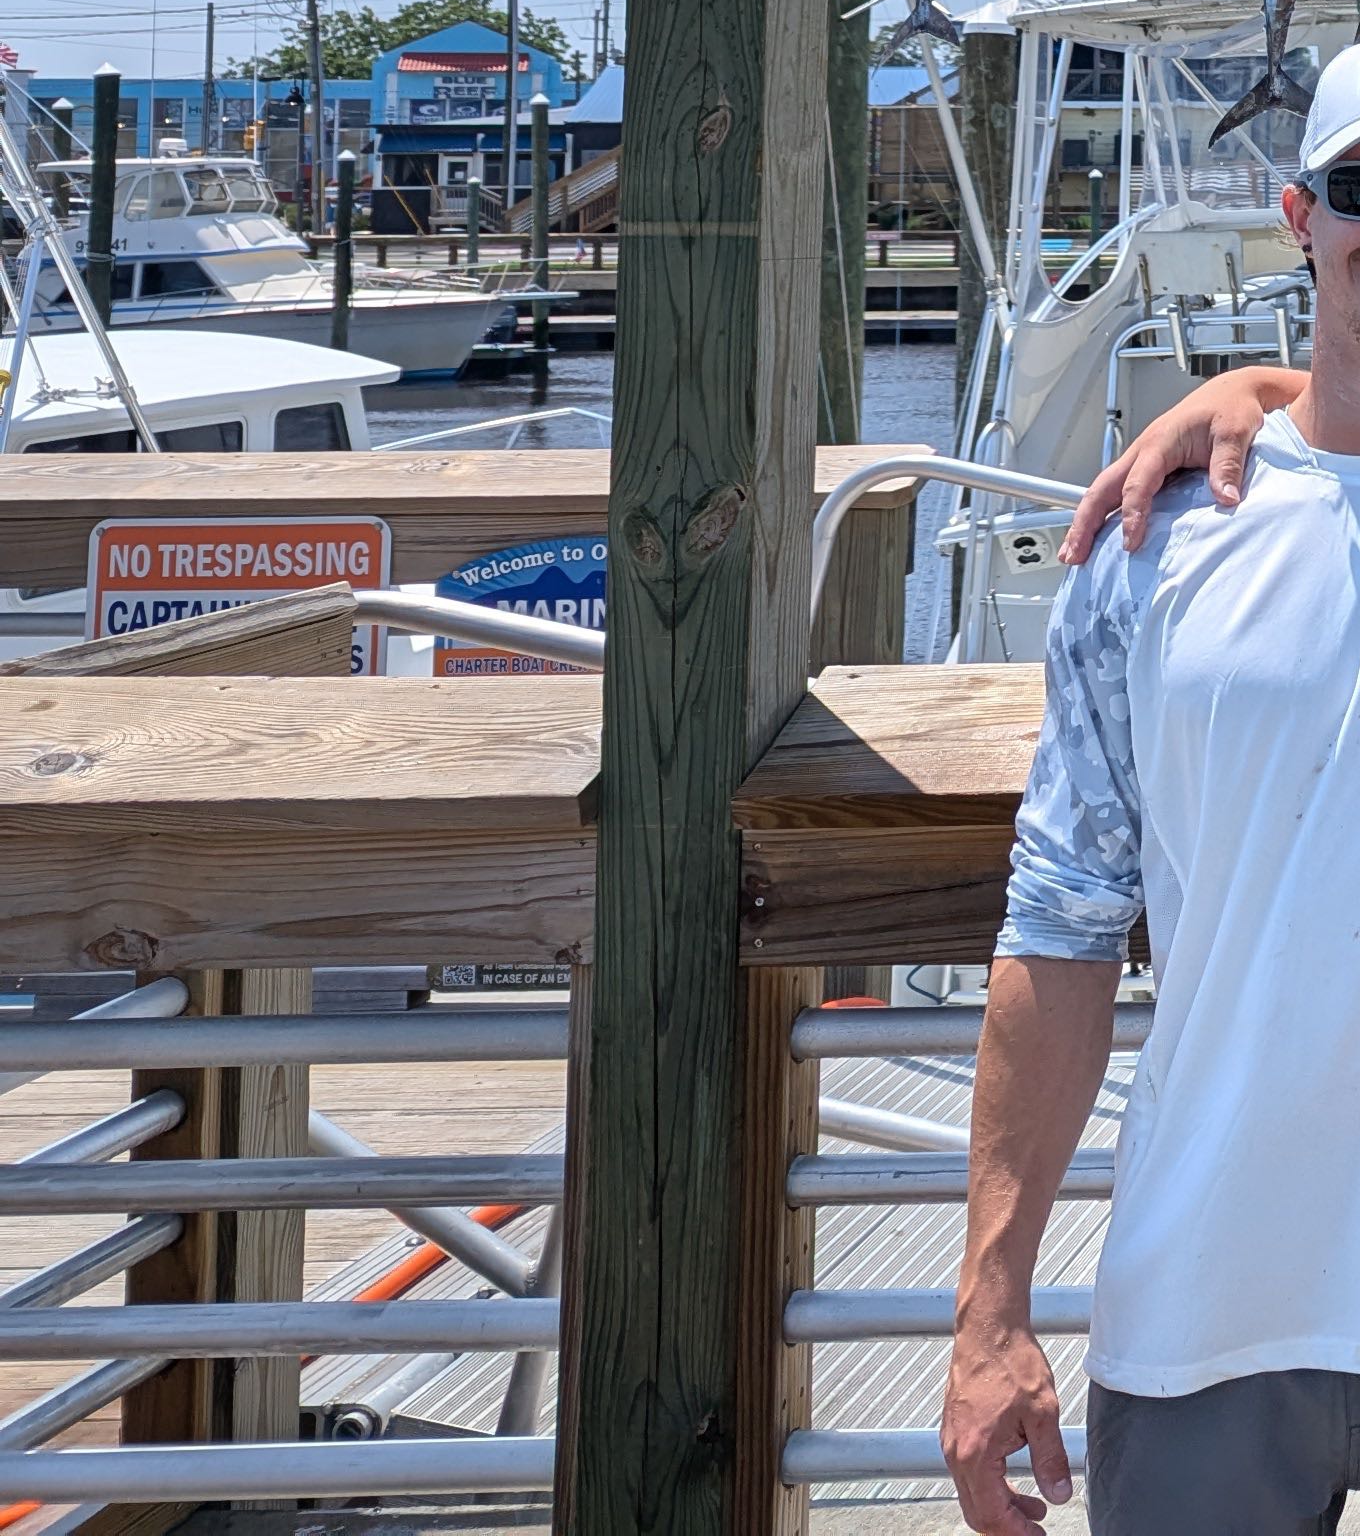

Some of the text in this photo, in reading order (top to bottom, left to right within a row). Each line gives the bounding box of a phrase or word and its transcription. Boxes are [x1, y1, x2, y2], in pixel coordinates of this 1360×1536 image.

[108, 541, 370, 578] NO TRESPASSING
[460, 551, 555, 587] Welcome
[561, 545, 584, 562] to
[445, 658, 508, 674] CHARTER
[511, 657, 545, 673] BOAT
[482, 973, 493, 985] IN
[494, 973, 522, 984] CASE
[524, 973, 538, 984] OF
[539, 973, 556, 984] AN
